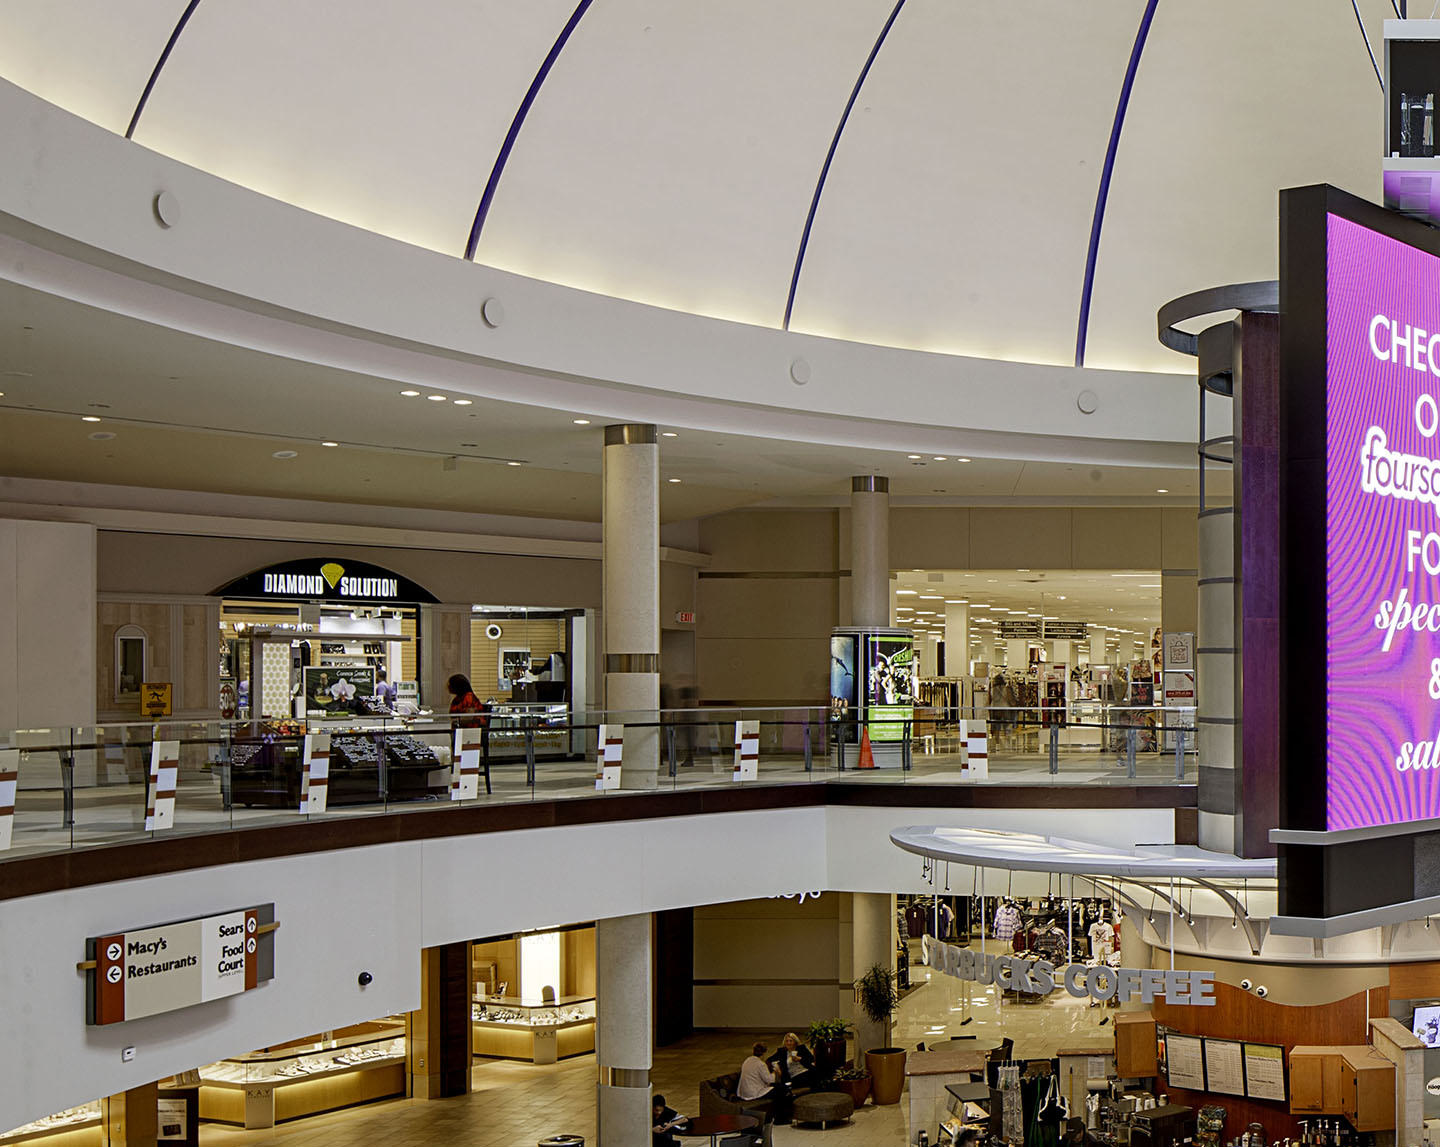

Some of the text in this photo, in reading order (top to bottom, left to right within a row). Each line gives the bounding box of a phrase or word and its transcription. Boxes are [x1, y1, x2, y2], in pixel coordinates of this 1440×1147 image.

[264, 573, 398, 597] DIAMOND SOLUTION
[680, 612, 694, 623] EXIT
[218, 924, 244, 938] Sears
[127, 937, 167, 956] Macy's
[222, 941, 244, 958] Food
[127, 955, 197, 979] Restaurants
[218, 958, 244, 973] Court
[922, 934, 1217, 1006] STARBUCKS COFFEE
